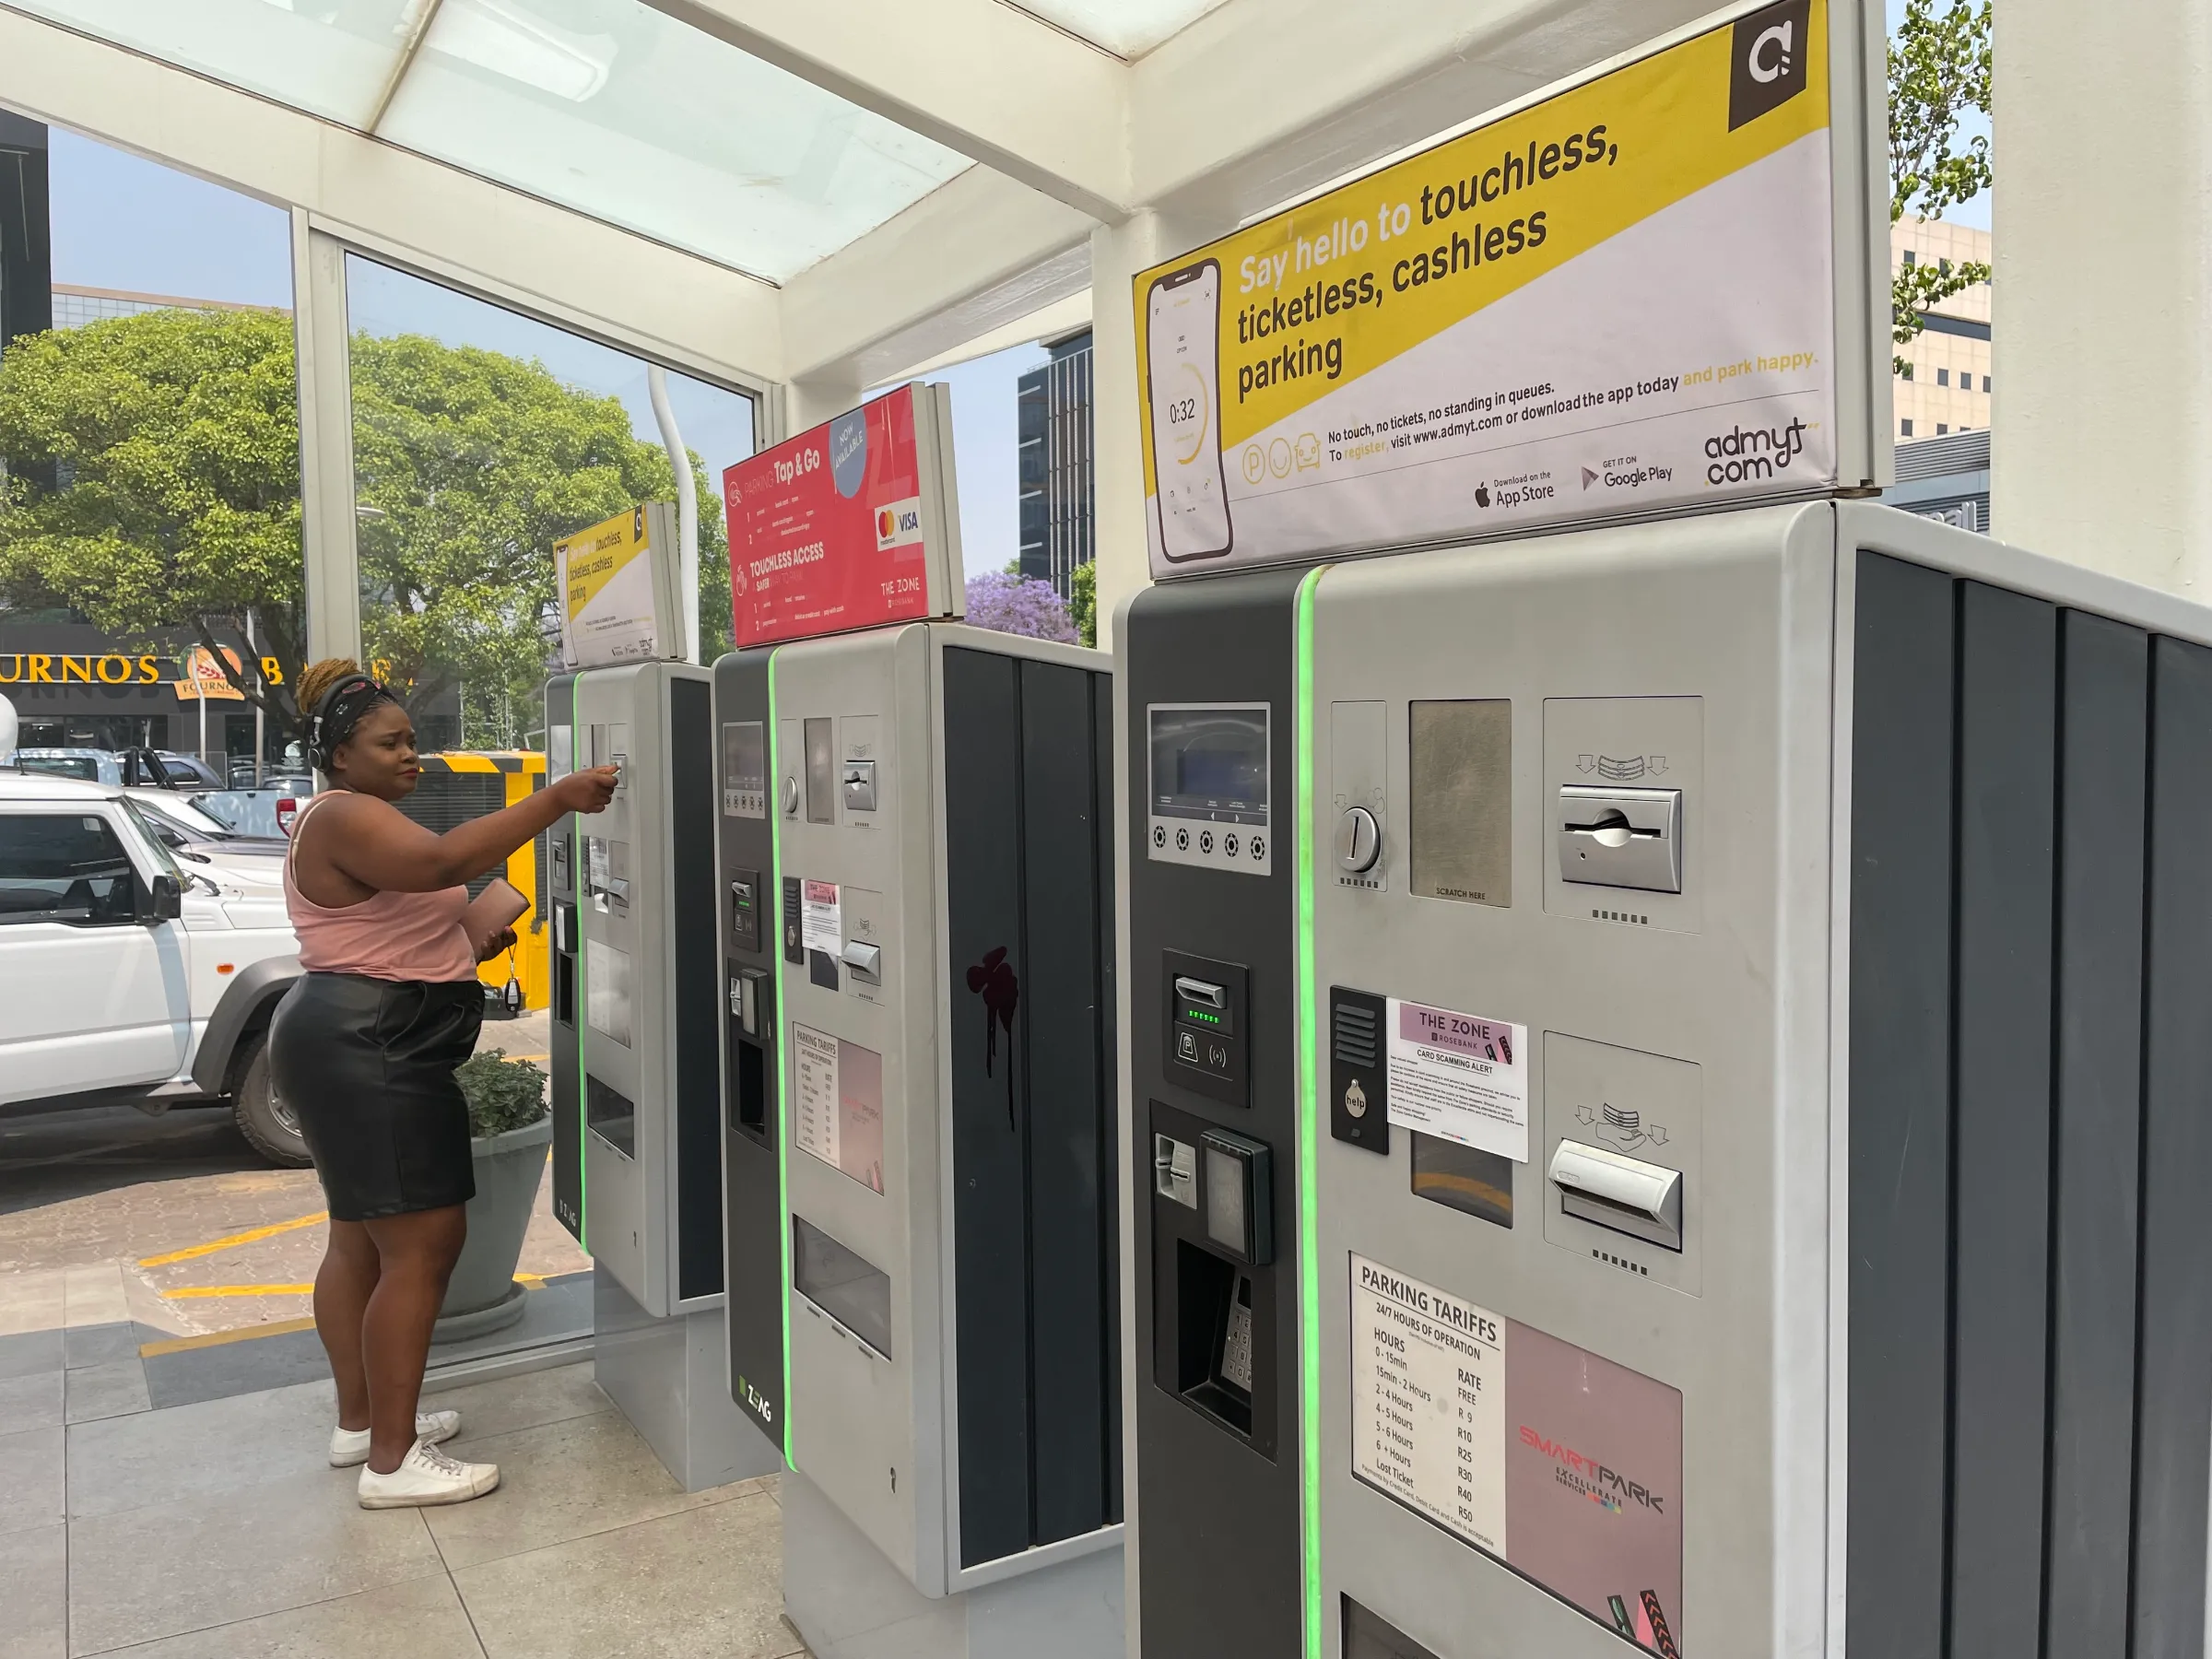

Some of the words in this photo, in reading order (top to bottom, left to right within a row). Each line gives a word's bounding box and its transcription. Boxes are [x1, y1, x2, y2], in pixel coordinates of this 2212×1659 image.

[1240, 252, 1288, 292] Say
[1296, 216, 1368, 275] hello
[1379, 203, 1411, 241] to
[1420, 124, 1618, 226] touchless,
[1238, 273, 1383, 345] ticketless,
[1393, 210, 1547, 292] cashless
[1239, 336, 1343, 403] parking
[1170, 398, 1195, 424] 0:32
[1328, 449, 1342, 463] To
[1344, 441, 1389, 460] register,
[1391, 433, 1412, 449] visit
[1413, 416, 1502, 445] www.admyt.com
[1505, 411, 1519, 424] or
[1522, 394, 1581, 421] download
[1583, 392, 1605, 408] the
[1607, 384, 1633, 405] app
[1637, 375, 1679, 395] today
[1683, 370, 1712, 387] and
[1717, 359, 1753, 383] park
[1758, 351, 1819, 372] happy.
[1328, 431, 1342, 443] No
[1344, 423, 1374, 440] touch,
[1376, 421, 1389, 433] no
[1390, 412, 1427, 431] tickets,
[1429, 408, 1442, 421] no
[1444, 394, 1492, 418] standing
[1495, 392, 1506, 406] in
[1508, 382, 1555, 406] queues.
[840, 423, 853, 447] NOW
[1704, 417, 1807, 468] admyt
[835, 430, 865, 471] AVAILABLE
[1603, 458, 1617, 469] GET
[1618, 457, 1625, 467] IT
[1626, 455, 1638, 465] ON
[774, 461, 794, 486] Tap
[795, 452, 803, 477] &
[804, 448, 820, 473] Go
[1494, 474, 1528, 488] Download
[1529, 473, 1539, 483] on
[1540, 470, 1551, 480] the
[1604, 467, 1648, 488] Google
[1649, 465, 1673, 483] Play
[1496, 488, 1521, 509] App
[1523, 483, 1555, 502] Store
[898, 512, 919, 532] VISA
[750, 550, 793, 579] TOUCHLESS
[794, 541, 824, 567] ACCESS
[757, 578, 771, 592] SAFER
[881, 581, 895, 596] THE
[897, 577, 920, 593] ZONE
[1436, 887, 1467, 898] SCRATCH
[1469, 890, 1487, 900] HERE
[1419, 1012, 1445, 1030] THE
[1452, 1019, 1490, 1041] ZONE
[796, 1030, 817, 1049] PARKING
[818, 1038, 836, 1055] TARIFFS
[1440, 1034, 1477, 1050] ROSEBANK
[1417, 1049, 1434, 1060] CARD
[1436, 1053, 1470, 1069] SCAMMING
[1471, 1062, 1493, 1075] ALERT
[1347, 1095, 1365, 1110] help
[1362, 1265, 1428, 1312] PARKING
[1433, 1296, 1497, 1342] TARIFFS
[1374, 1327, 1405, 1352] HOURS
[1376, 1302, 1392, 1318] 24/7
[1394, 1310, 1420, 1332] HOURS
[1422, 1324, 1432, 1337] OF
[1434, 1329, 1480, 1360] OPERATION
[1375, 1346, 1381, 1357] 0
[1385, 1351, 1407, 1371] 15min
[1376, 1365, 1397, 1384] 15min
[1403, 1379, 1407, 1390] 2
[1409, 1381, 1431, 1402] Hours
[1458, 1368, 1481, 1391] RATE
[1376, 1383, 1381, 1394] 2
[1385, 1389, 1391, 1400] 4
[1392, 1392, 1413, 1412] Hours
[1458, 1387, 1477, 1406] FREE
[1375, 1403, 1381, 1413] 4
[1385, 1407, 1391, 1418] 5
[1392, 1411, 1413, 1431] Hours
[1458, 1407, 1464, 1419] R
[1467, 1412, 1473, 1423] 9
[1376, 1420, 1381, 1431] 5
[1386, 1426, 1391, 1438] 6
[1392, 1430, 1414, 1451] Hours
[1457, 1426, 1472, 1443] R10
[1376, 1440, 1381, 1451] 6
[1390, 1447, 1411, 1468] Hours
[1457, 1446, 1472, 1464] R25
[1376, 1457, 1392, 1476] Lost
[1393, 1467, 1414, 1489] Ticket
[1458, 1465, 1473, 1483] R30
[1520, 1425, 1664, 1514] SMARTPARK
[1457, 1485, 1472, 1502] R40
[1556, 1475, 1586, 1496] SERVICES
[1557, 1467, 1622, 1508] EXCELLERATE
[1361, 1464, 1382, 1482] Payments
[1389, 1480, 1403, 1493] Credit
[1404, 1488, 1416, 1501] Card,
[1416, 1495, 1429, 1509] Debit
[1429, 1503, 1440, 1515] Card
[1441, 1510, 1450, 1521] and
[1451, 1516, 1463, 1529] Cash
[1468, 1527, 1494, 1547] acceptable
[1458, 1505, 1473, 1523] R50
